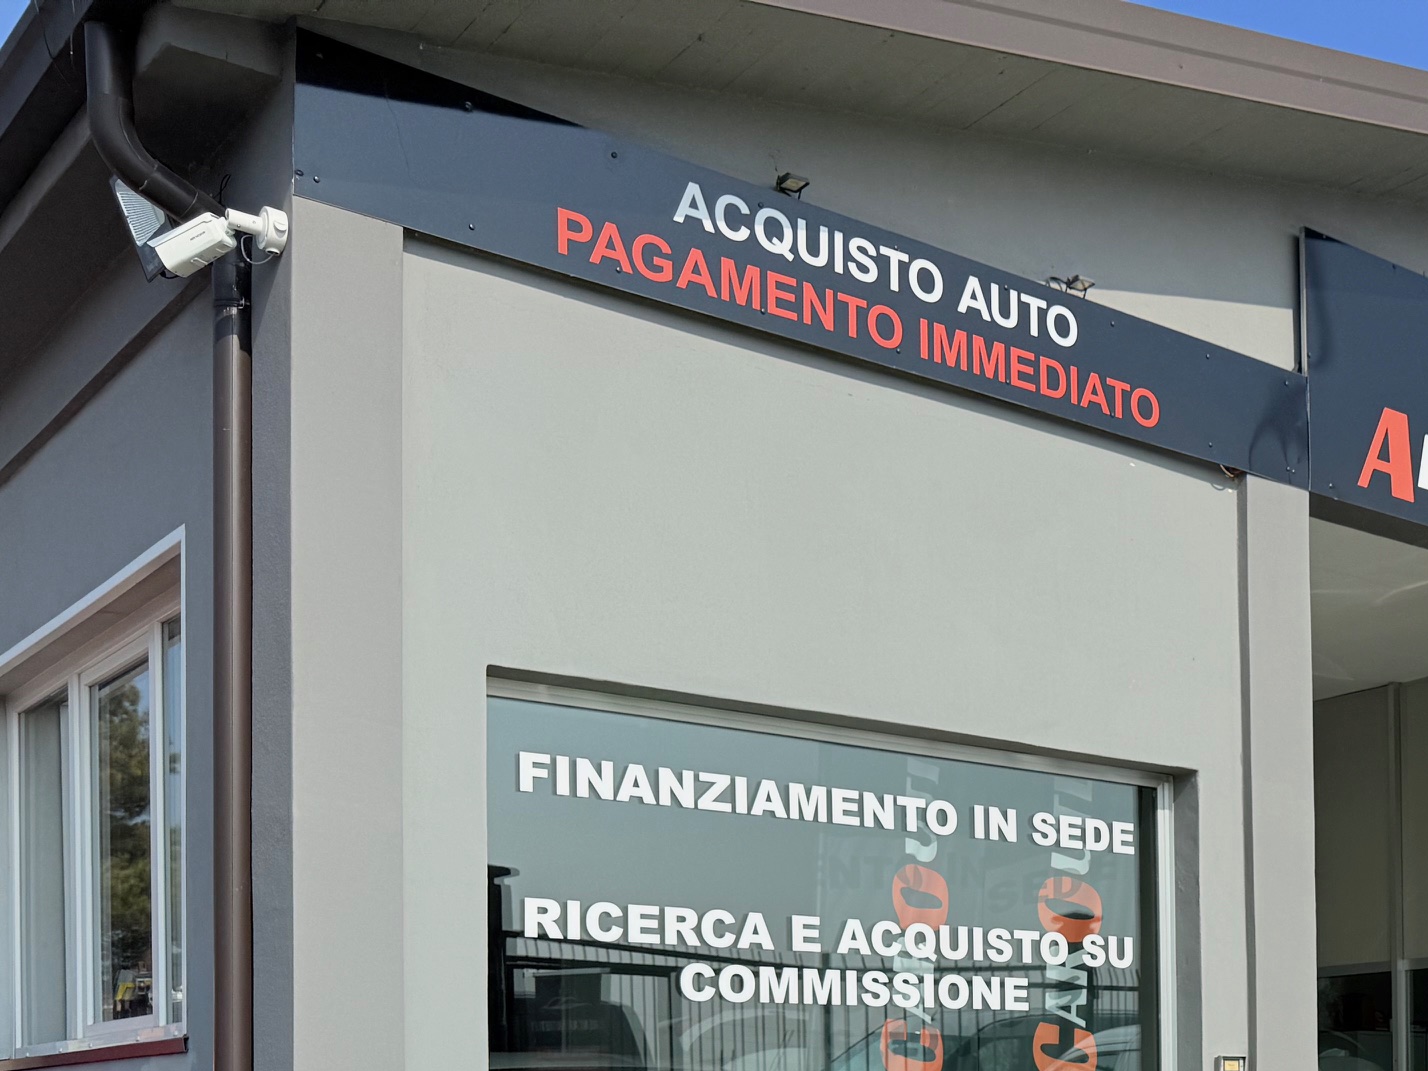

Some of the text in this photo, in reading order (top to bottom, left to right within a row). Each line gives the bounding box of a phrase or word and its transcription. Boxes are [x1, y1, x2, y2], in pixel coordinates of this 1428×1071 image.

[557, 208, 1160, 428] PAGAMENTO IMMEDIATO
[673, 182, 1078, 348] ACQUISTO AUTO
[518, 750, 1136, 856] FINANZIAMENTO IN SEDE
[524, 897, 1134, 970] RICERCA E ACQUISTO SU
[680, 962, 1030, 1012] COMMISSIONE
